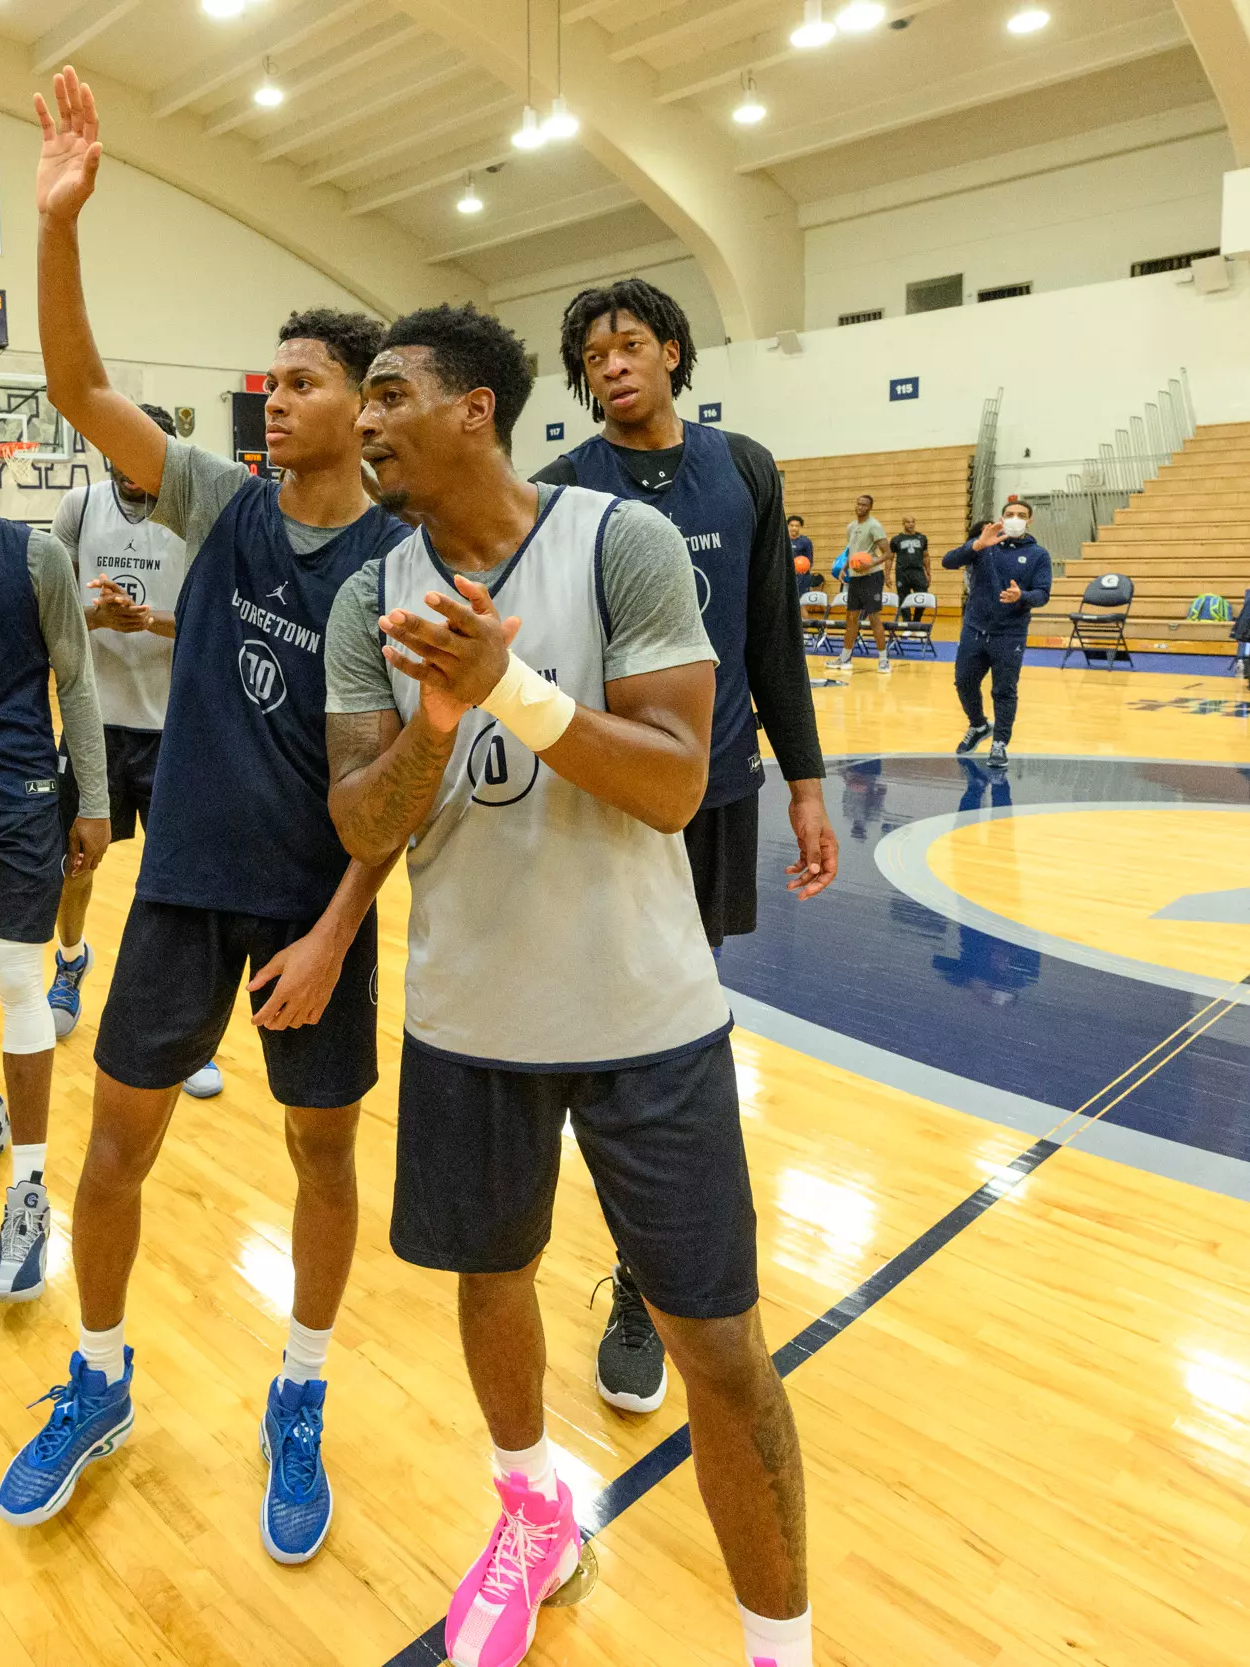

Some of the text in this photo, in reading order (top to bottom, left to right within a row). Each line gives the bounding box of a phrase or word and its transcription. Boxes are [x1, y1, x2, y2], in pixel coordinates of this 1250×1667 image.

[895, 383, 913, 395] 115
[703, 409, 718, 418] 116
[96, 556, 161, 570] GEORGETOWN
[245, 651, 276, 700] 10
[484, 735, 508, 785] 0
[24, 1192, 39, 1208] G
